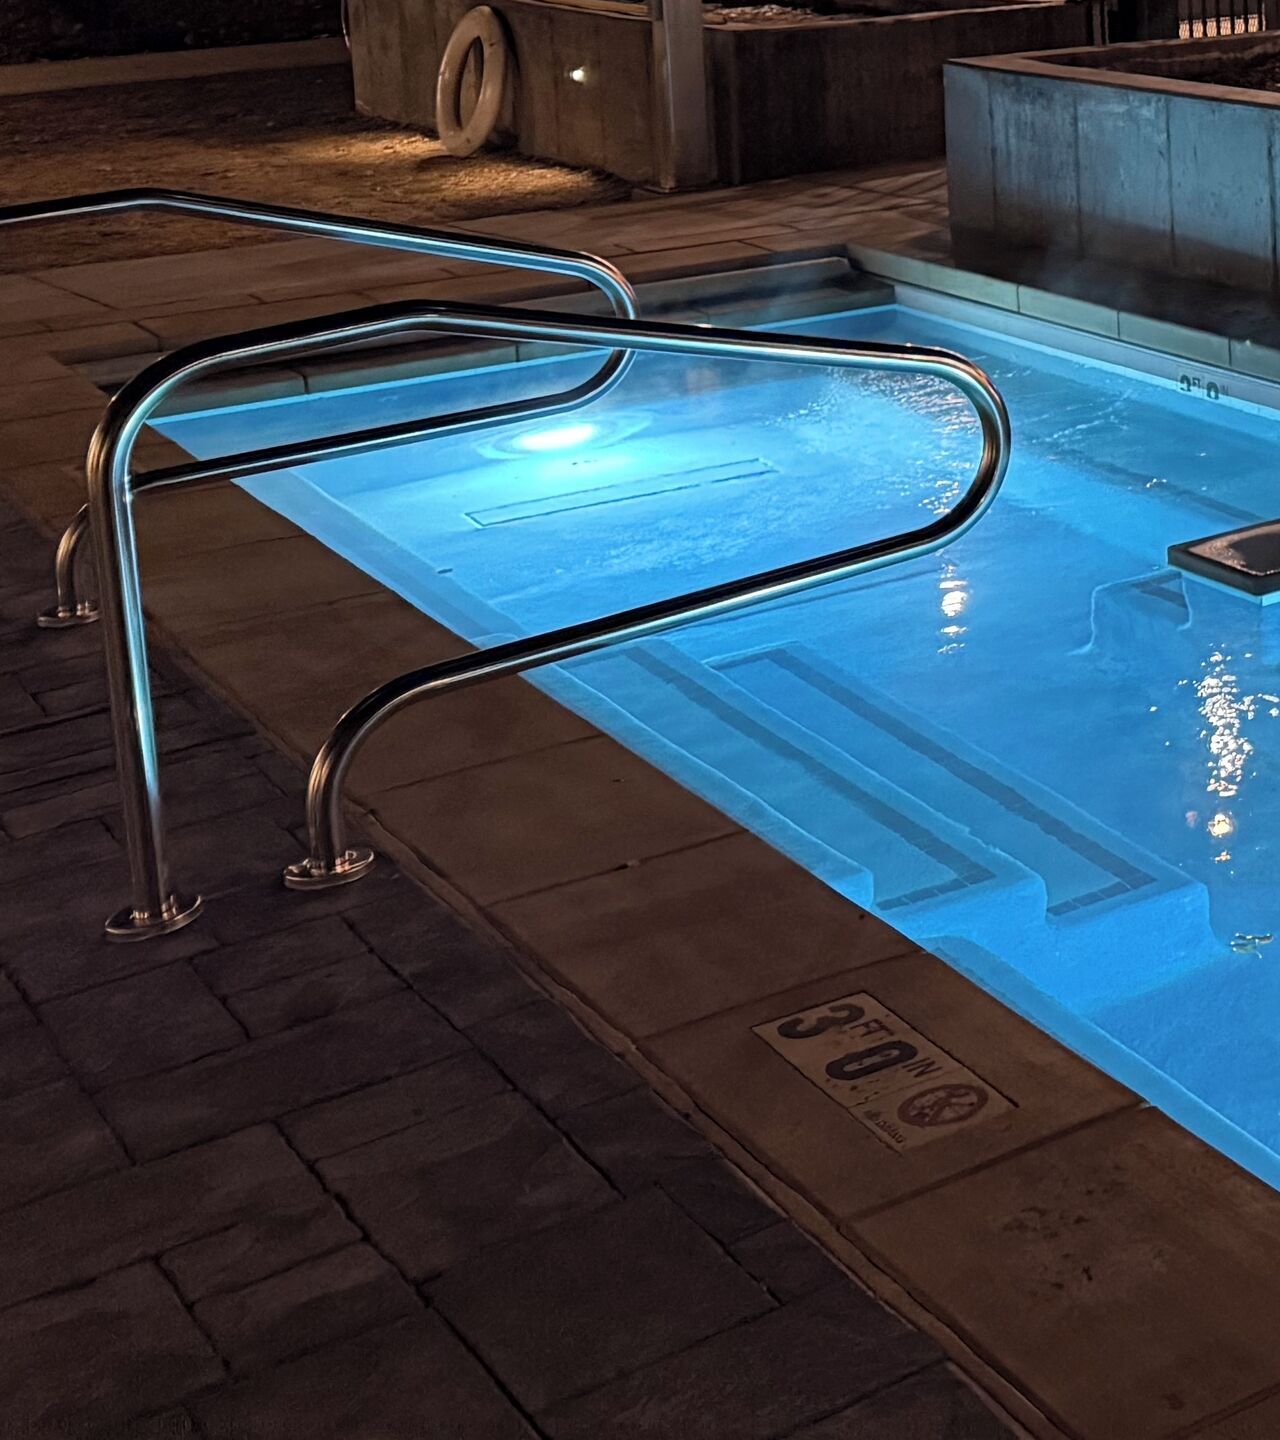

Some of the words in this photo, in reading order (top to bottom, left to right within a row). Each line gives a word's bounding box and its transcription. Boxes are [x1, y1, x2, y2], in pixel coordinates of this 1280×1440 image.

[1206, 381, 1219, 400] 0
[777, 1003, 865, 1039] 3
[849, 1018, 894, 1038] FT
[825, 1040, 918, 1081] 0
[902, 1057, 943, 1078] IN
